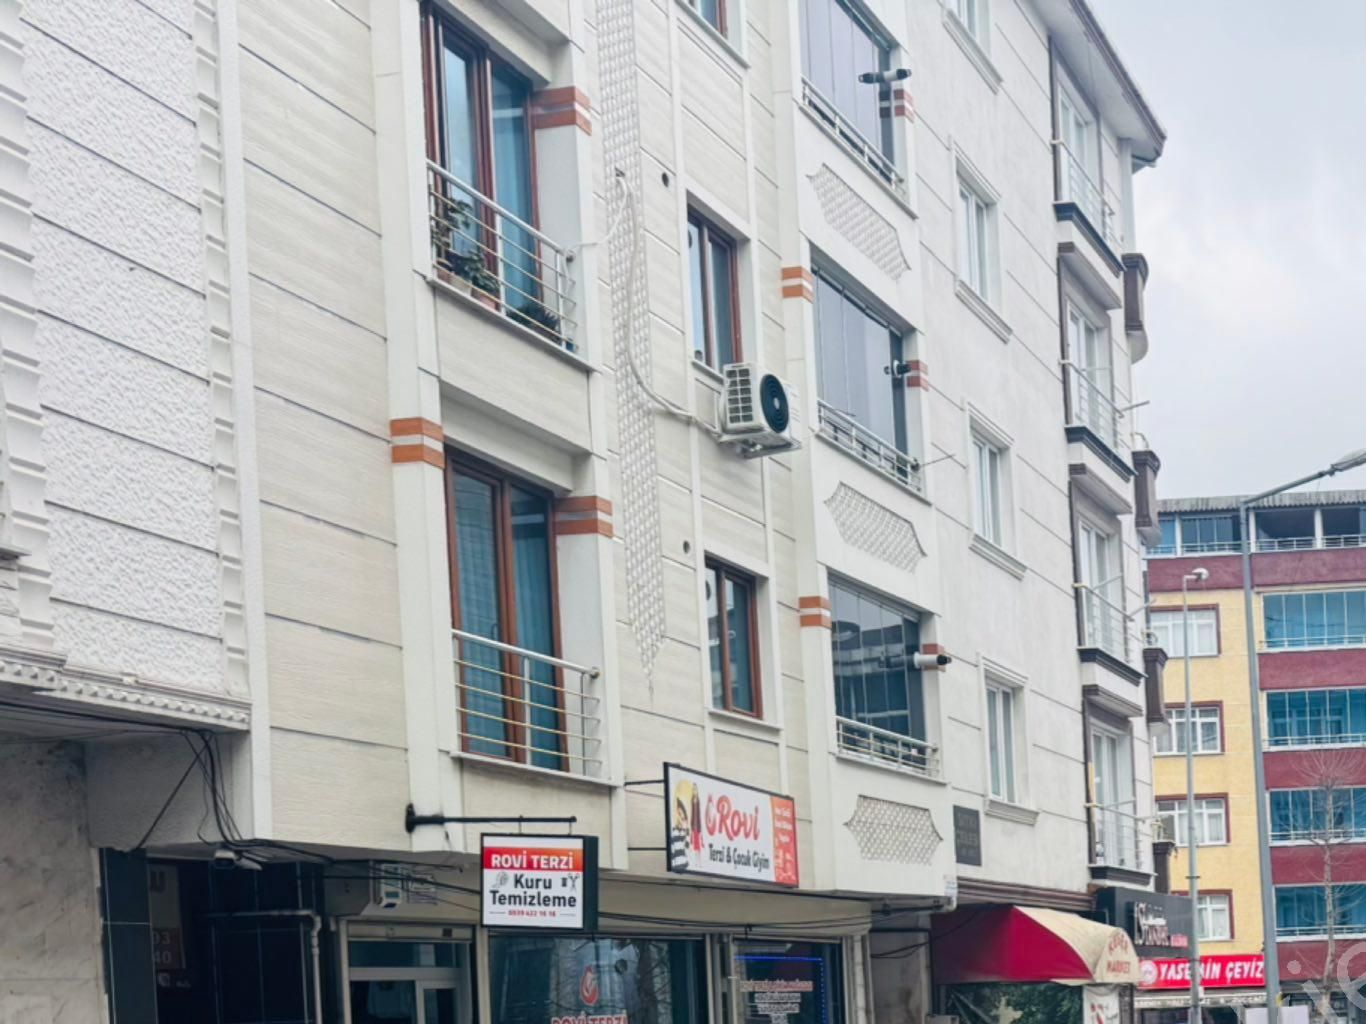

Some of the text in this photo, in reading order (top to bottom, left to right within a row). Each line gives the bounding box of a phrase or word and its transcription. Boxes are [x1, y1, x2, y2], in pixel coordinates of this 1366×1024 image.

[716, 794, 760, 841] Rovi
[491, 850, 573, 870] ROVİ TERZİ
[708, 843, 725, 862] Terzi
[732, 847, 752, 869] Çocuk
[513, 873, 553, 890] Kuru
[489, 890, 577, 908] Temizleme
[1225, 958, 1265, 984] ÇEYİZ
